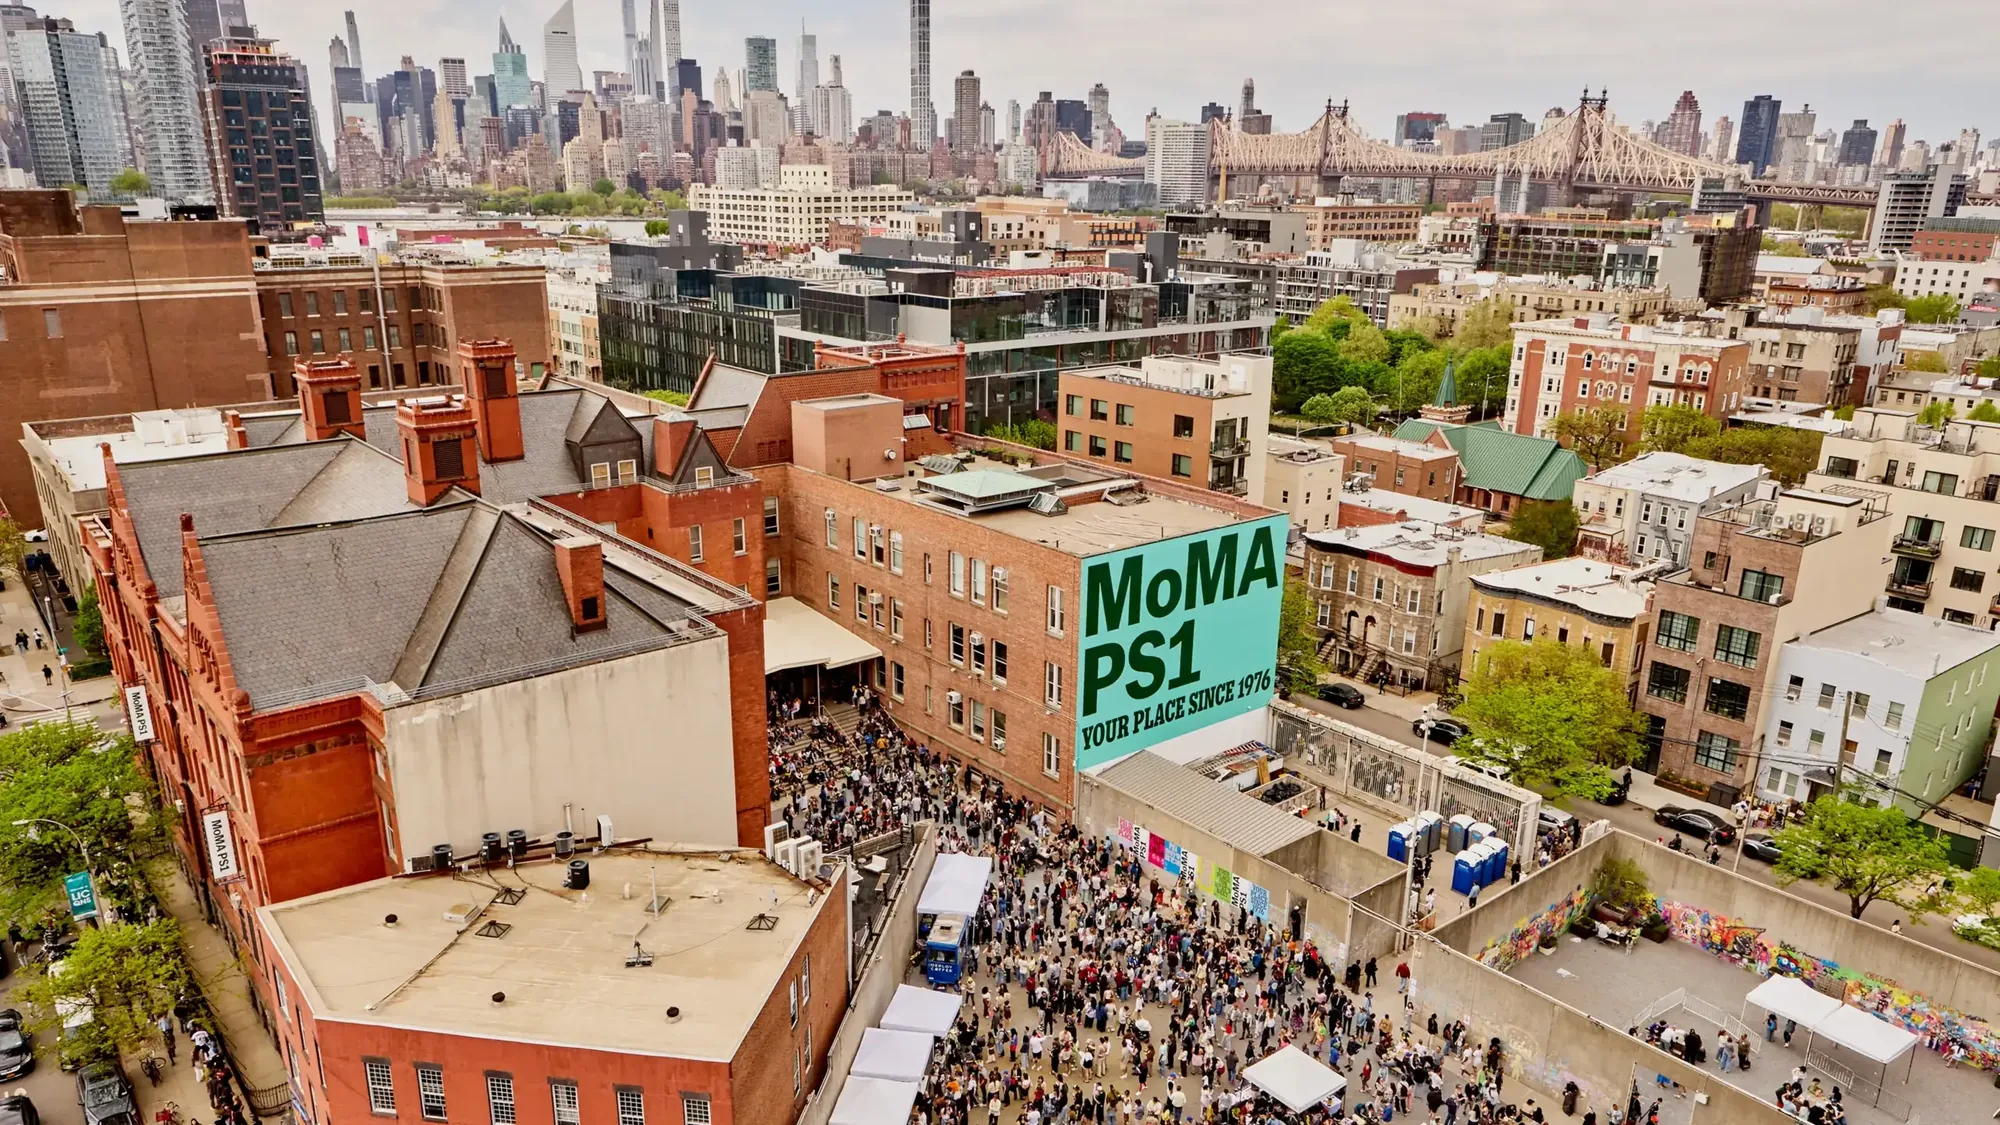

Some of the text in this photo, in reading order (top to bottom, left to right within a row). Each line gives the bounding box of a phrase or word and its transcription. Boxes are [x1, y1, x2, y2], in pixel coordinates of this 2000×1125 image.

[1086, 526, 1278, 637] MoMA
[1083, 619, 1201, 717] PS1
[132, 692, 148, 735] MoMA PS1
[1082, 669, 1271, 750] YOUR PLACE SINCE 1976
[211, 819, 230, 873] MoMA PS1
[1139, 841, 1147, 859] PS1
[71, 889, 90, 901] LIC
[1231, 876, 1240, 907] MoMA
